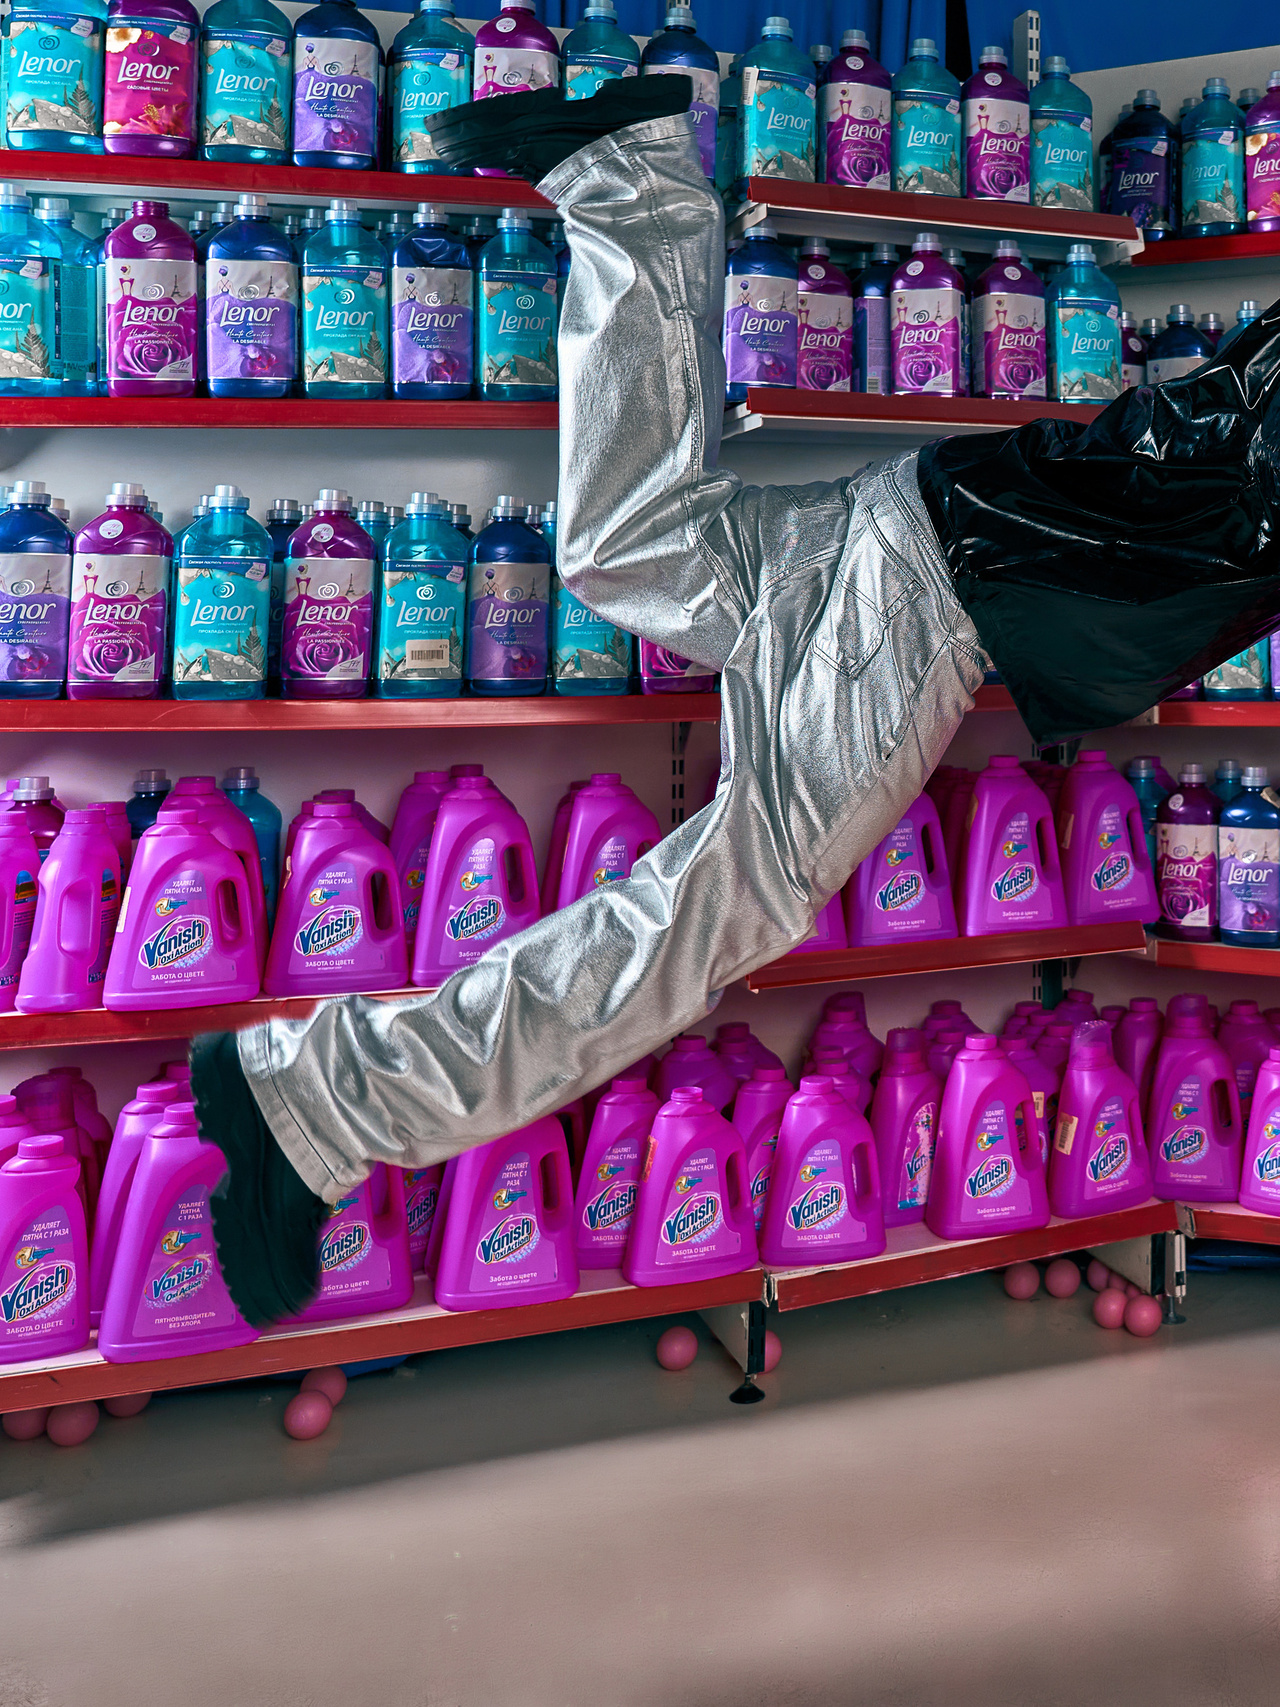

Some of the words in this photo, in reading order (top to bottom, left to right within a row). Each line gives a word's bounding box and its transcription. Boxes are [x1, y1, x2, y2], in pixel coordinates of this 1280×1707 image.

[18, 51, 80, 77] Lenor
[118, 57, 179, 83] Lenor
[216, 69, 275, 93] Lenor
[305, 75, 362, 101] Lenor
[400, 89, 449, 110] Lenor
[767, 108, 811, 131] Lenor
[842, 119, 887, 142] Lenor
[908, 126, 953, 148] Lenor
[980, 133, 1024, 155] Lenor
[1045, 143, 1087, 164] Lenor
[1118, 171, 1159, 192] Lenor
[123, 301, 184, 326] Lenor
[220, 300, 280, 326] Lenor
[316, 303, 373, 329] Lenor
[407, 307, 463, 332] Lenor
[498, 309, 550, 334] Lenor
[740, 315, 789, 336] Lenor
[801, 328, 846, 349] Lenor
[900, 326, 946, 347] Lenor
[999, 327, 1041, 349] Lenor
[1072, 332, 1114, 353] Lenor
[0, 603, 56, 624] enor
[84, 598, 149, 626] Lenor
[191, 597, 255, 626] Lenor
[297, 600, 359, 626] Lenor
[397, 601, 455, 627] Lenor
[485, 602, 540, 628] Lenor
[564, 604, 606, 628] Len
[325, 871, 347, 879] УДАЛЯЕТ
[1093, 853, 1130, 891] Vanish
[1160, 858, 1203, 881] Lenor
[1227, 862, 1273, 886] Lenor
[878, 873, 920, 912] Vanish
[994, 864, 1034, 902] Vanish
[299, 908, 357, 954] Vanish
[450, 899, 498, 941] Vanish
[144, 918, 203, 968] Vanish
[1163, 1128, 1201, 1161] Vanish
[1089, 1142, 1127, 1182] Vanish
[968, 1157, 1009, 1198] Vanish
[178, 1201, 205, 1209] УДАЛЯЕТ
[587, 1188, 637, 1230] Vanish
[791, 1184, 841, 1230] Vanish
[32, 1221, 61, 1232] УДАЛЯЕТ
[665, 1195, 716, 1245] Vanish
[22, 1232, 43, 1241] ПЯТНА
[53, 1229, 69, 1238] РАЗА
[322, 1225, 365, 1260] anish
[480, 1216, 531, 1265] Vanish
[672, 1248, 693, 1257] ЗАБОТА
[700, 1245, 717, 1254] ЦВЕТЕ
[153, 1260, 202, 1298] Vanish
[350, 1280, 369, 1289] цвете
[489, 1274, 512, 1283] Забота
[520, 1271, 538, 1280] цвете
[1, 1266, 67, 1323] Vanish
[6, 1324, 33, 1335] ЗАБОТА
[41, 1320, 64, 1330] ЦВЕТЕ
[155, 1312, 216, 1324] ПЯТНОВЫВОДИТЕЛЬ
